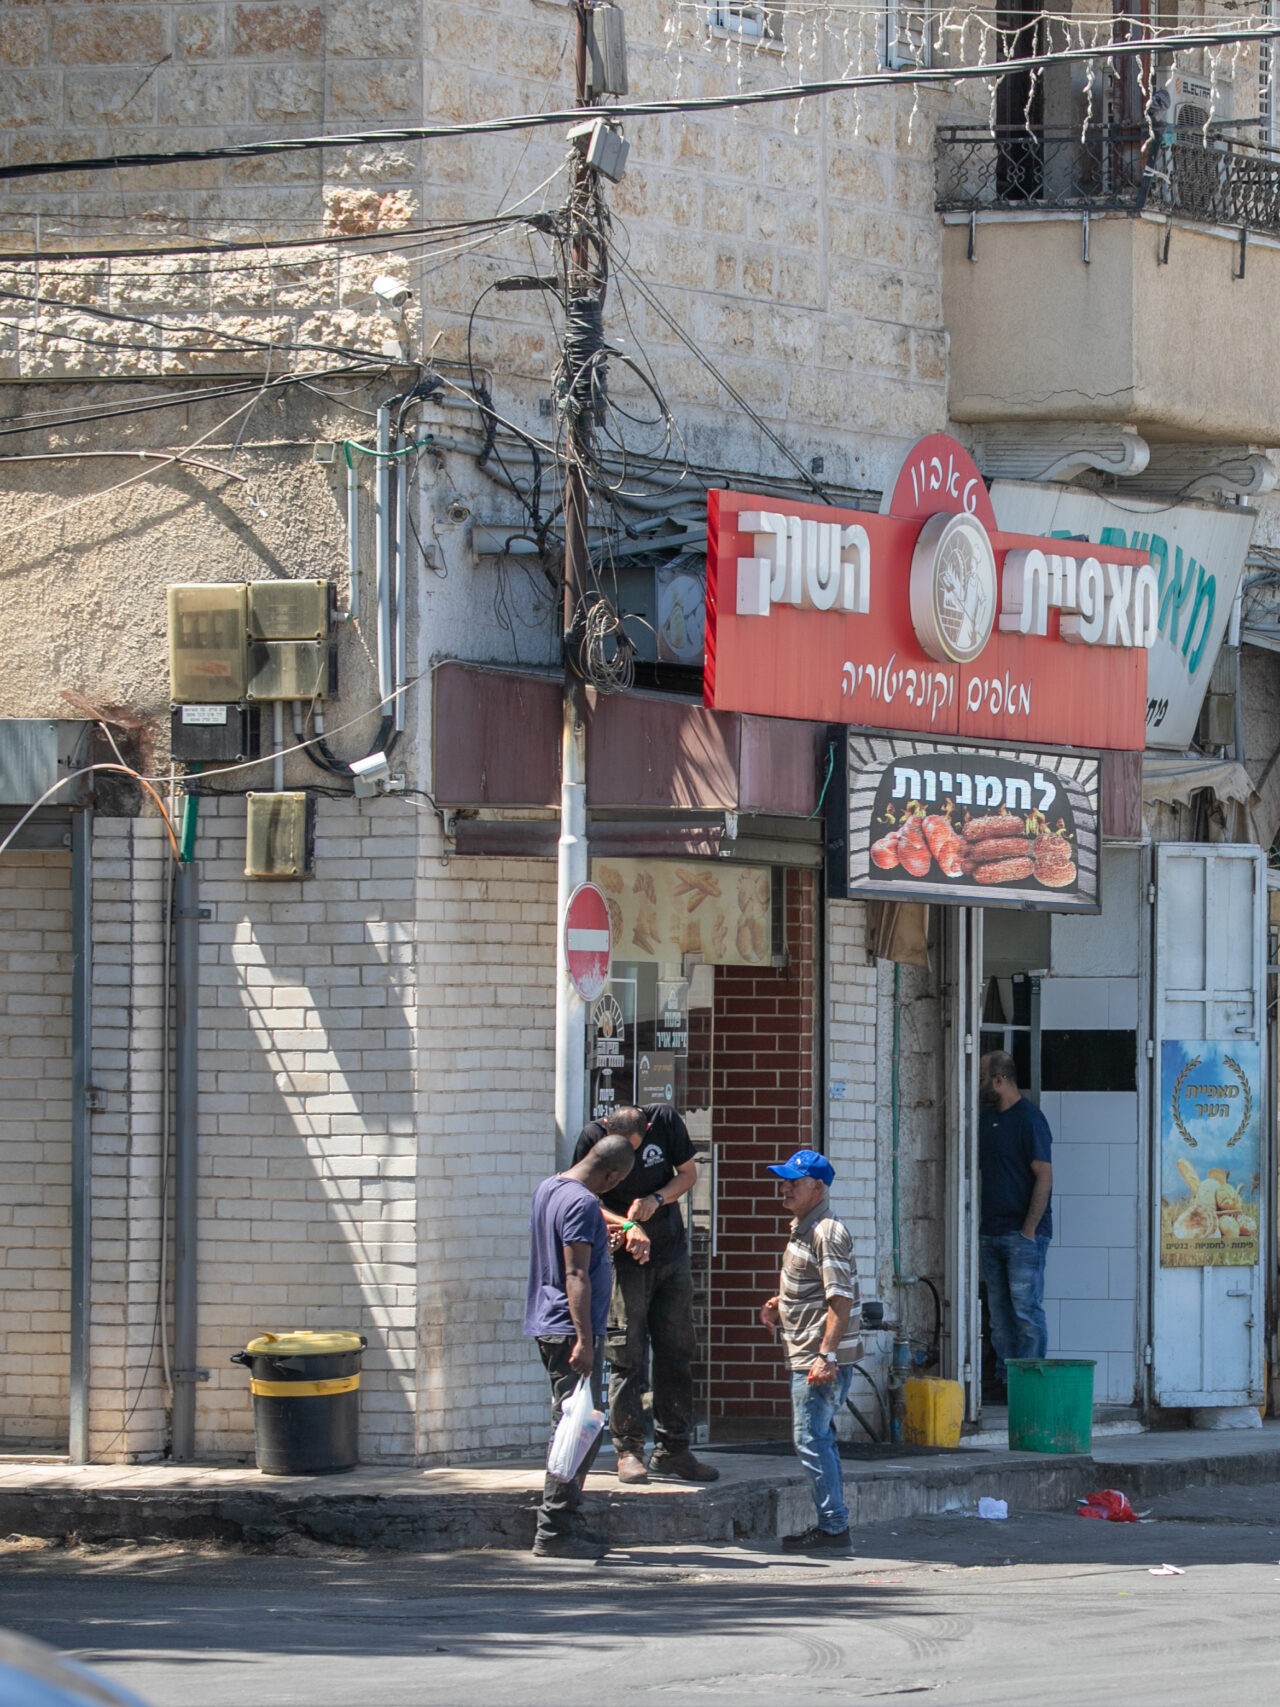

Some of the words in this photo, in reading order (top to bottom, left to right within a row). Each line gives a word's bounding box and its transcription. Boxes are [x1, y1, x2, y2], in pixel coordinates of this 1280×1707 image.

[910, 453, 978, 514] טאבון
[737, 510, 870, 617] השוק
[1000, 548, 1159, 649] מאפיית
[842, 653, 955, 724] וקונדיטוריה
[965, 670, 1032, 717] מאפים
[892, 766, 1057, 812] לחמניות
[1185, 1084, 1240, 1099] מאפיית
[1195, 1103, 1230, 1118] העיר
[1195, 1240, 1226, 1250] לחמניות
[1231, 1241, 1254, 1249] פיתות
